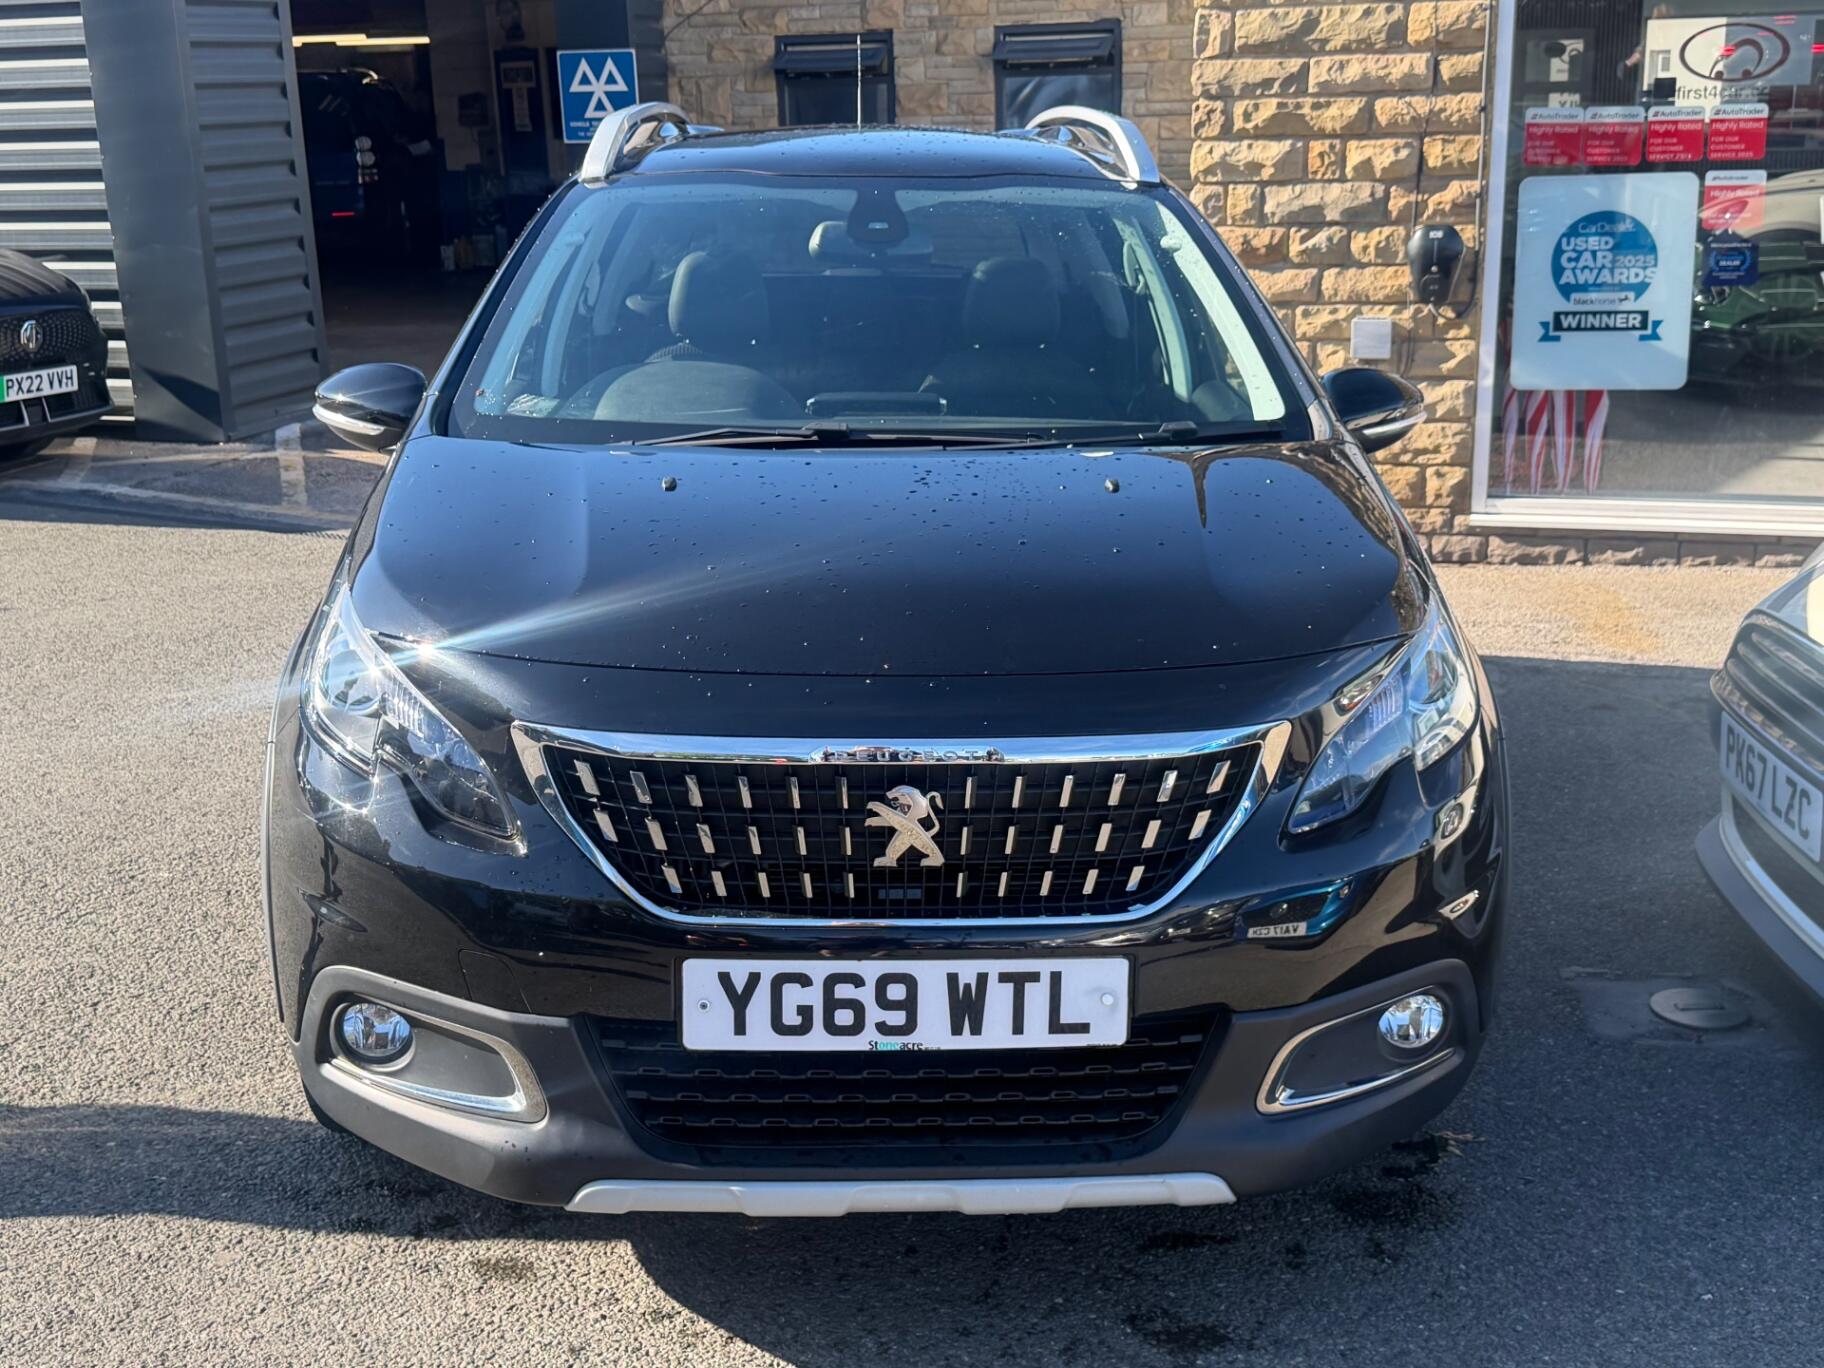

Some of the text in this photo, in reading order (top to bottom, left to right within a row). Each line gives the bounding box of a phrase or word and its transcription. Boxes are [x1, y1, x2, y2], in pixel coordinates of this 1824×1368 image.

[1598, 112, 1640, 120] AutoTrader
[1660, 110, 1703, 118] AutoTrader
[1722, 108, 1764, 116] AutoTrader
[1650, 122, 1702, 134] Highly Rated
[1712, 120, 1764, 131] Highly Rated
[1561, 236, 1614, 251] USED
[1560, 251, 1655, 269] CAR 2025
[1558, 267, 1657, 285] AWARDS
[1560, 313, 1641, 328] WINNER
[5, 368, 74, 398] PX22 VVH
[834, 750, 979, 763] PEUGEOT
[1726, 724, 1812, 841] PK67 LZC
[717, 970, 1091, 1037] YG69 WTL
[868, 1040, 924, 1050] Stoneacre
